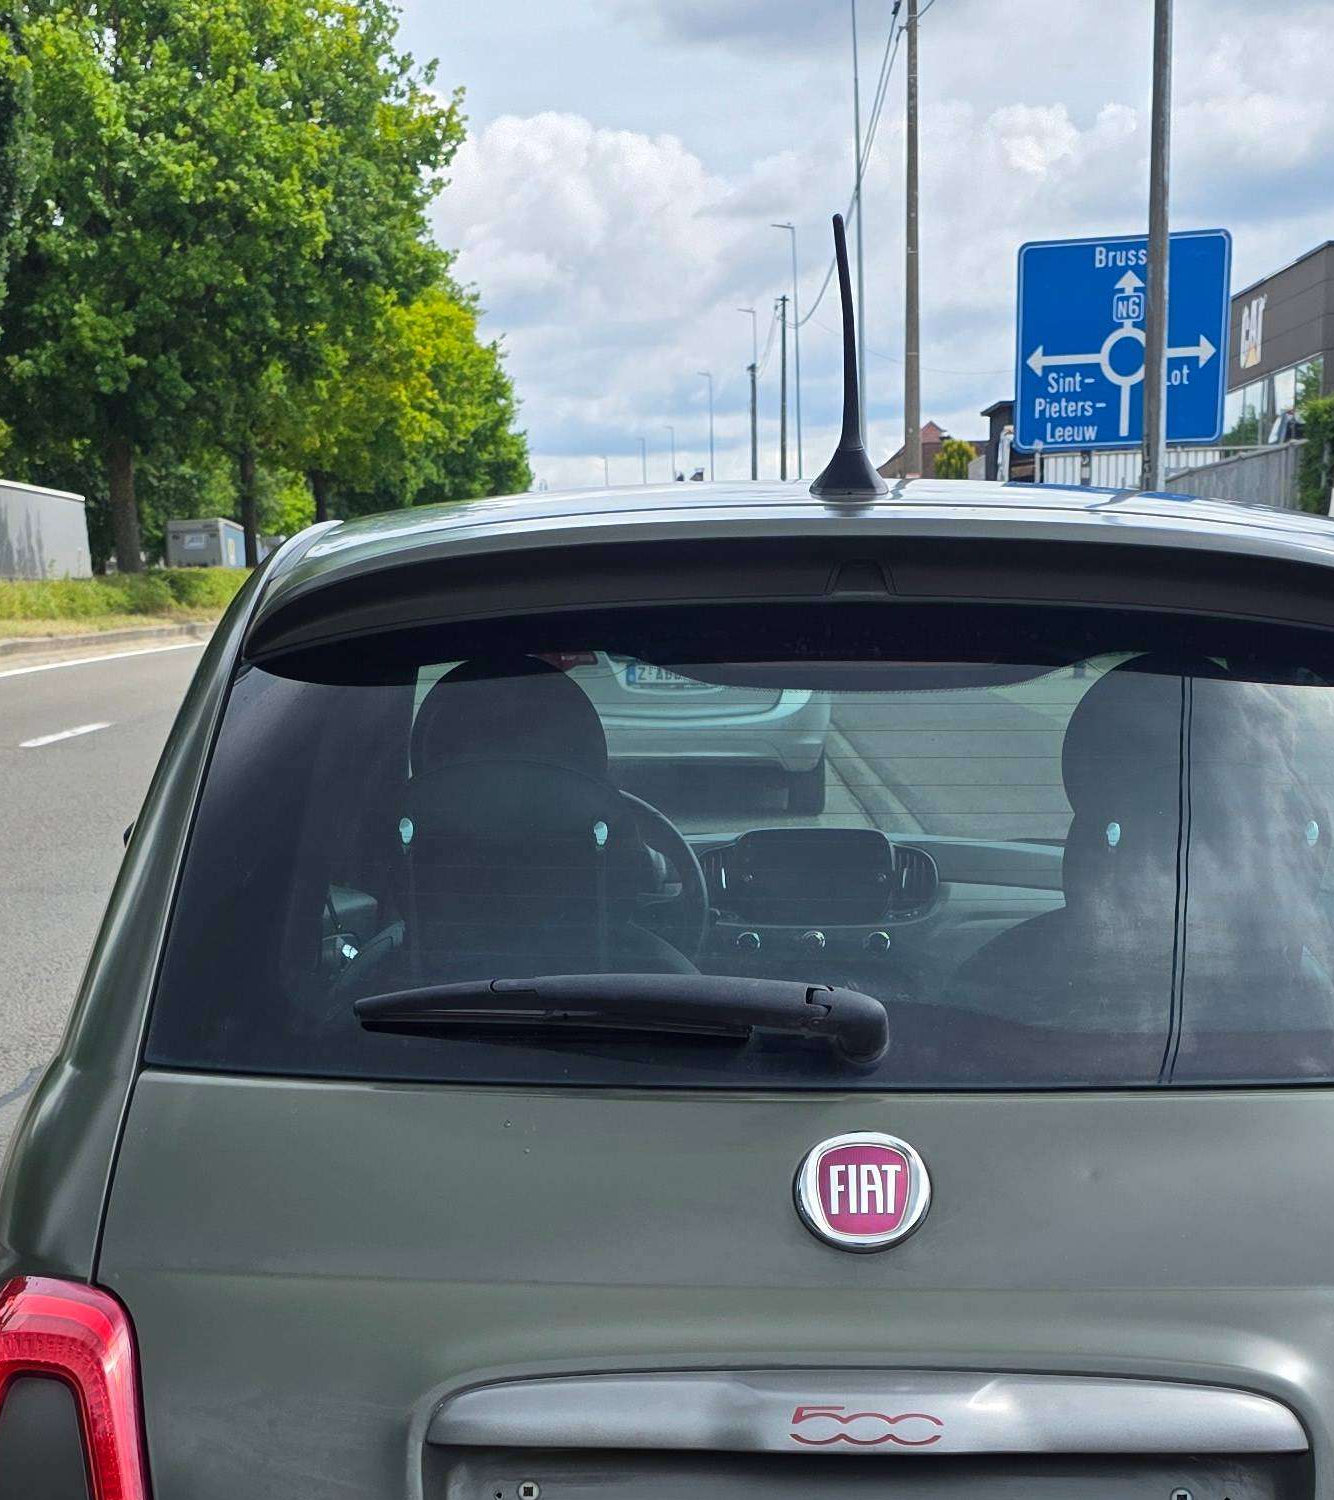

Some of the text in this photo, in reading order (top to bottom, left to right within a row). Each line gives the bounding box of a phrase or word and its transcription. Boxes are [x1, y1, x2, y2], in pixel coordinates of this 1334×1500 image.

[1095, 246, 1148, 268] Bruss
[1117, 297, 1140, 318] N6
[1047, 372, 1095, 393] Sint-
[1165, 364, 1190, 386] ot
[1034, 397, 1107, 419] Pieters-
[1046, 422, 1098, 443] Leeuw
[828, 1164, 901, 1215] FIAT
[789, 1406, 944, 1446] 500
